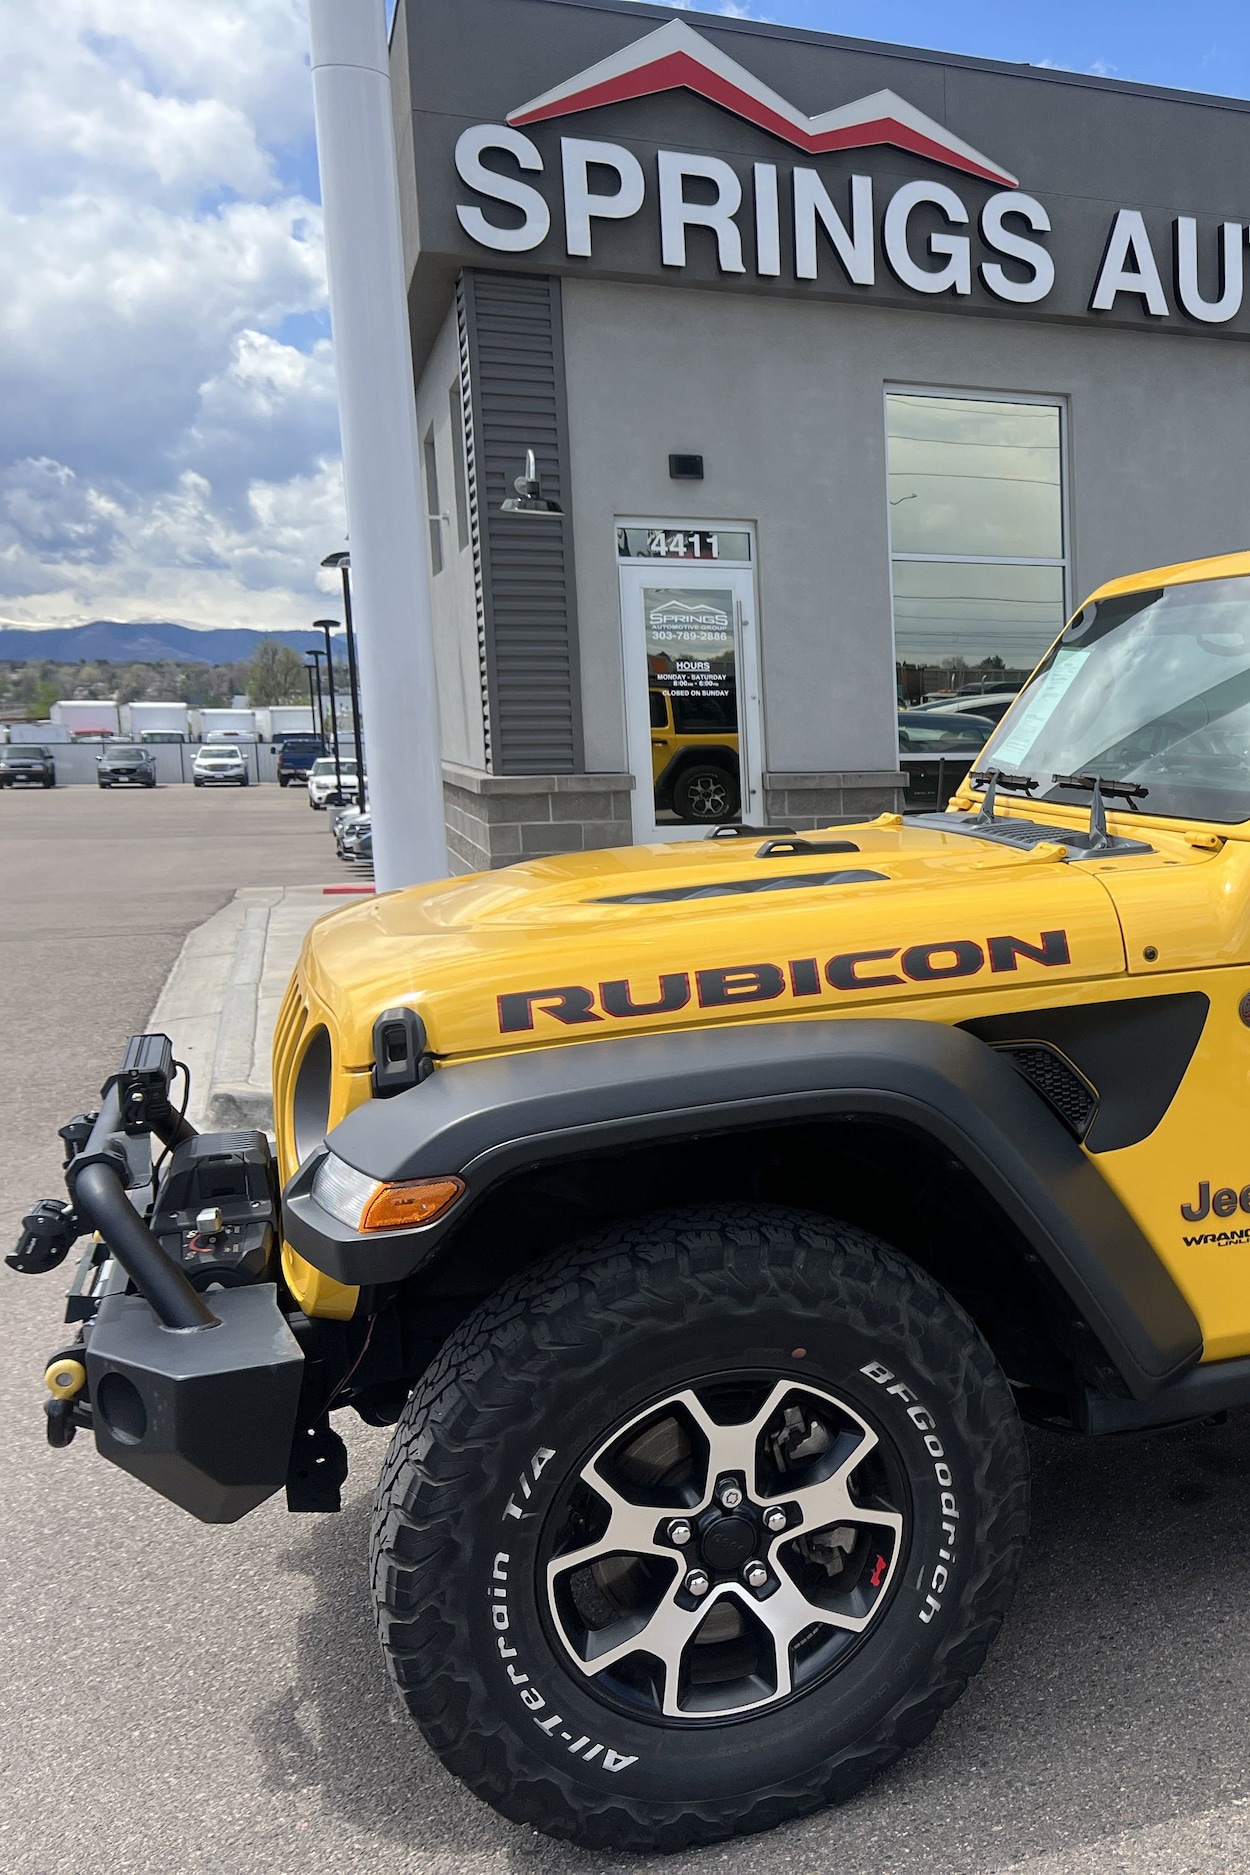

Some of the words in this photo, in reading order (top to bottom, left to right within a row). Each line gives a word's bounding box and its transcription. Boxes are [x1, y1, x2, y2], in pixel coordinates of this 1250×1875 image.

[454, 124, 1055, 304] SPRINGS
[650, 532, 719, 558] 4411
[650, 613, 728, 626] SPRINGS
[652, 631, 728, 641] 303-789-2886
[657, 673, 686, 681] MONDAY
[676, 661, 711, 671] HOURS
[662, 689, 690, 697] CLOSED
[496, 929, 1072, 1034] RUBICON
[501, 1446, 557, 1523] T/A
[858, 1360, 962, 1624] BFGoodrich
[486, 1551, 640, 1773] All-Terrain
